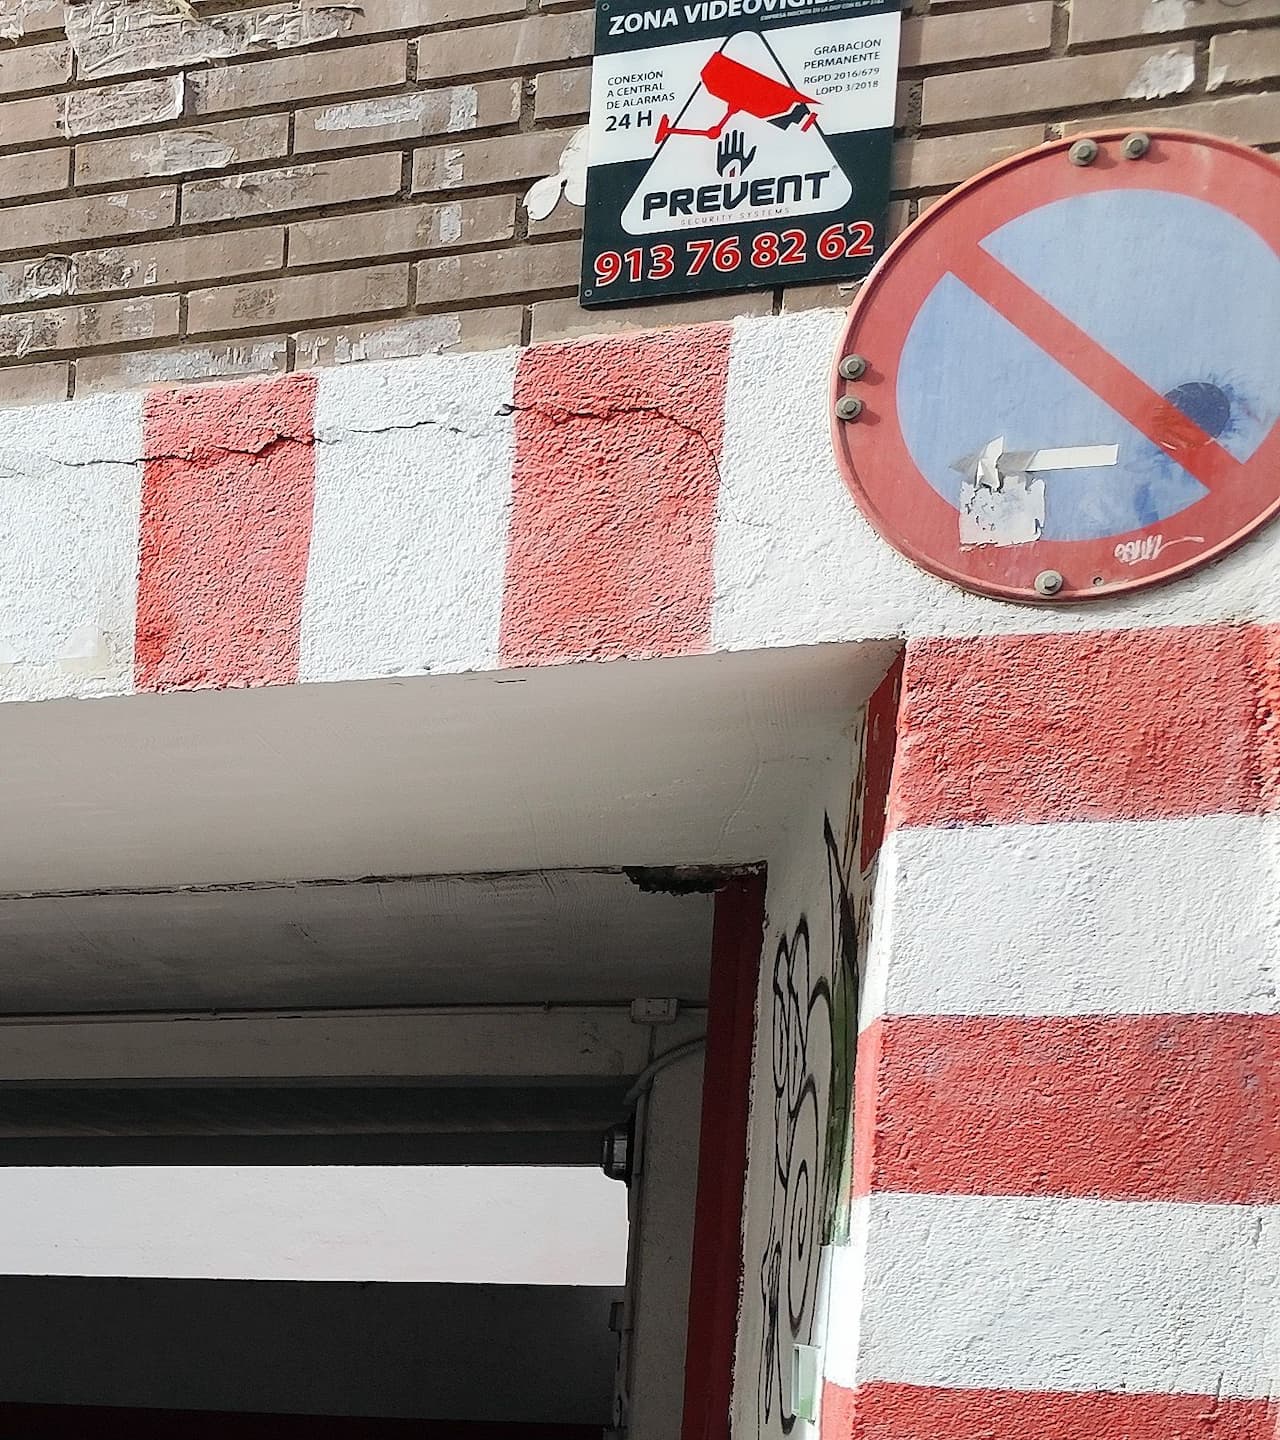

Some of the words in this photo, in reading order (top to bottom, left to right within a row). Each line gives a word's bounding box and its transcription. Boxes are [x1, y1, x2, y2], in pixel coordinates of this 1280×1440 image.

[608, 7, 679, 36] ZONA
[803, 51, 881, 70] PERMANENTE
[803, 73, 832, 85] RGPD
[833, 67, 880, 81] 2016/679
[606, 89, 614, 98] A
[616, 82, 665, 97] CENTRAL
[815, 85, 843, 96] LOPD
[845, 80, 879, 92] 3/2018
[606, 100, 620, 110] DE
[622, 92, 676, 108] ALARMAS
[605, 113, 631, 132] 24
[637, 110, 652, 128] H
[642, 170, 831, 221] PREVENT
[680, 213, 733, 226] SECURITY
[739, 207, 790, 219] SYSTEMS
[593, 244, 675, 287] 913
[686, 236, 742, 276] 76
[750, 229, 807, 267] 82
[816, 221, 874, 260] 62
